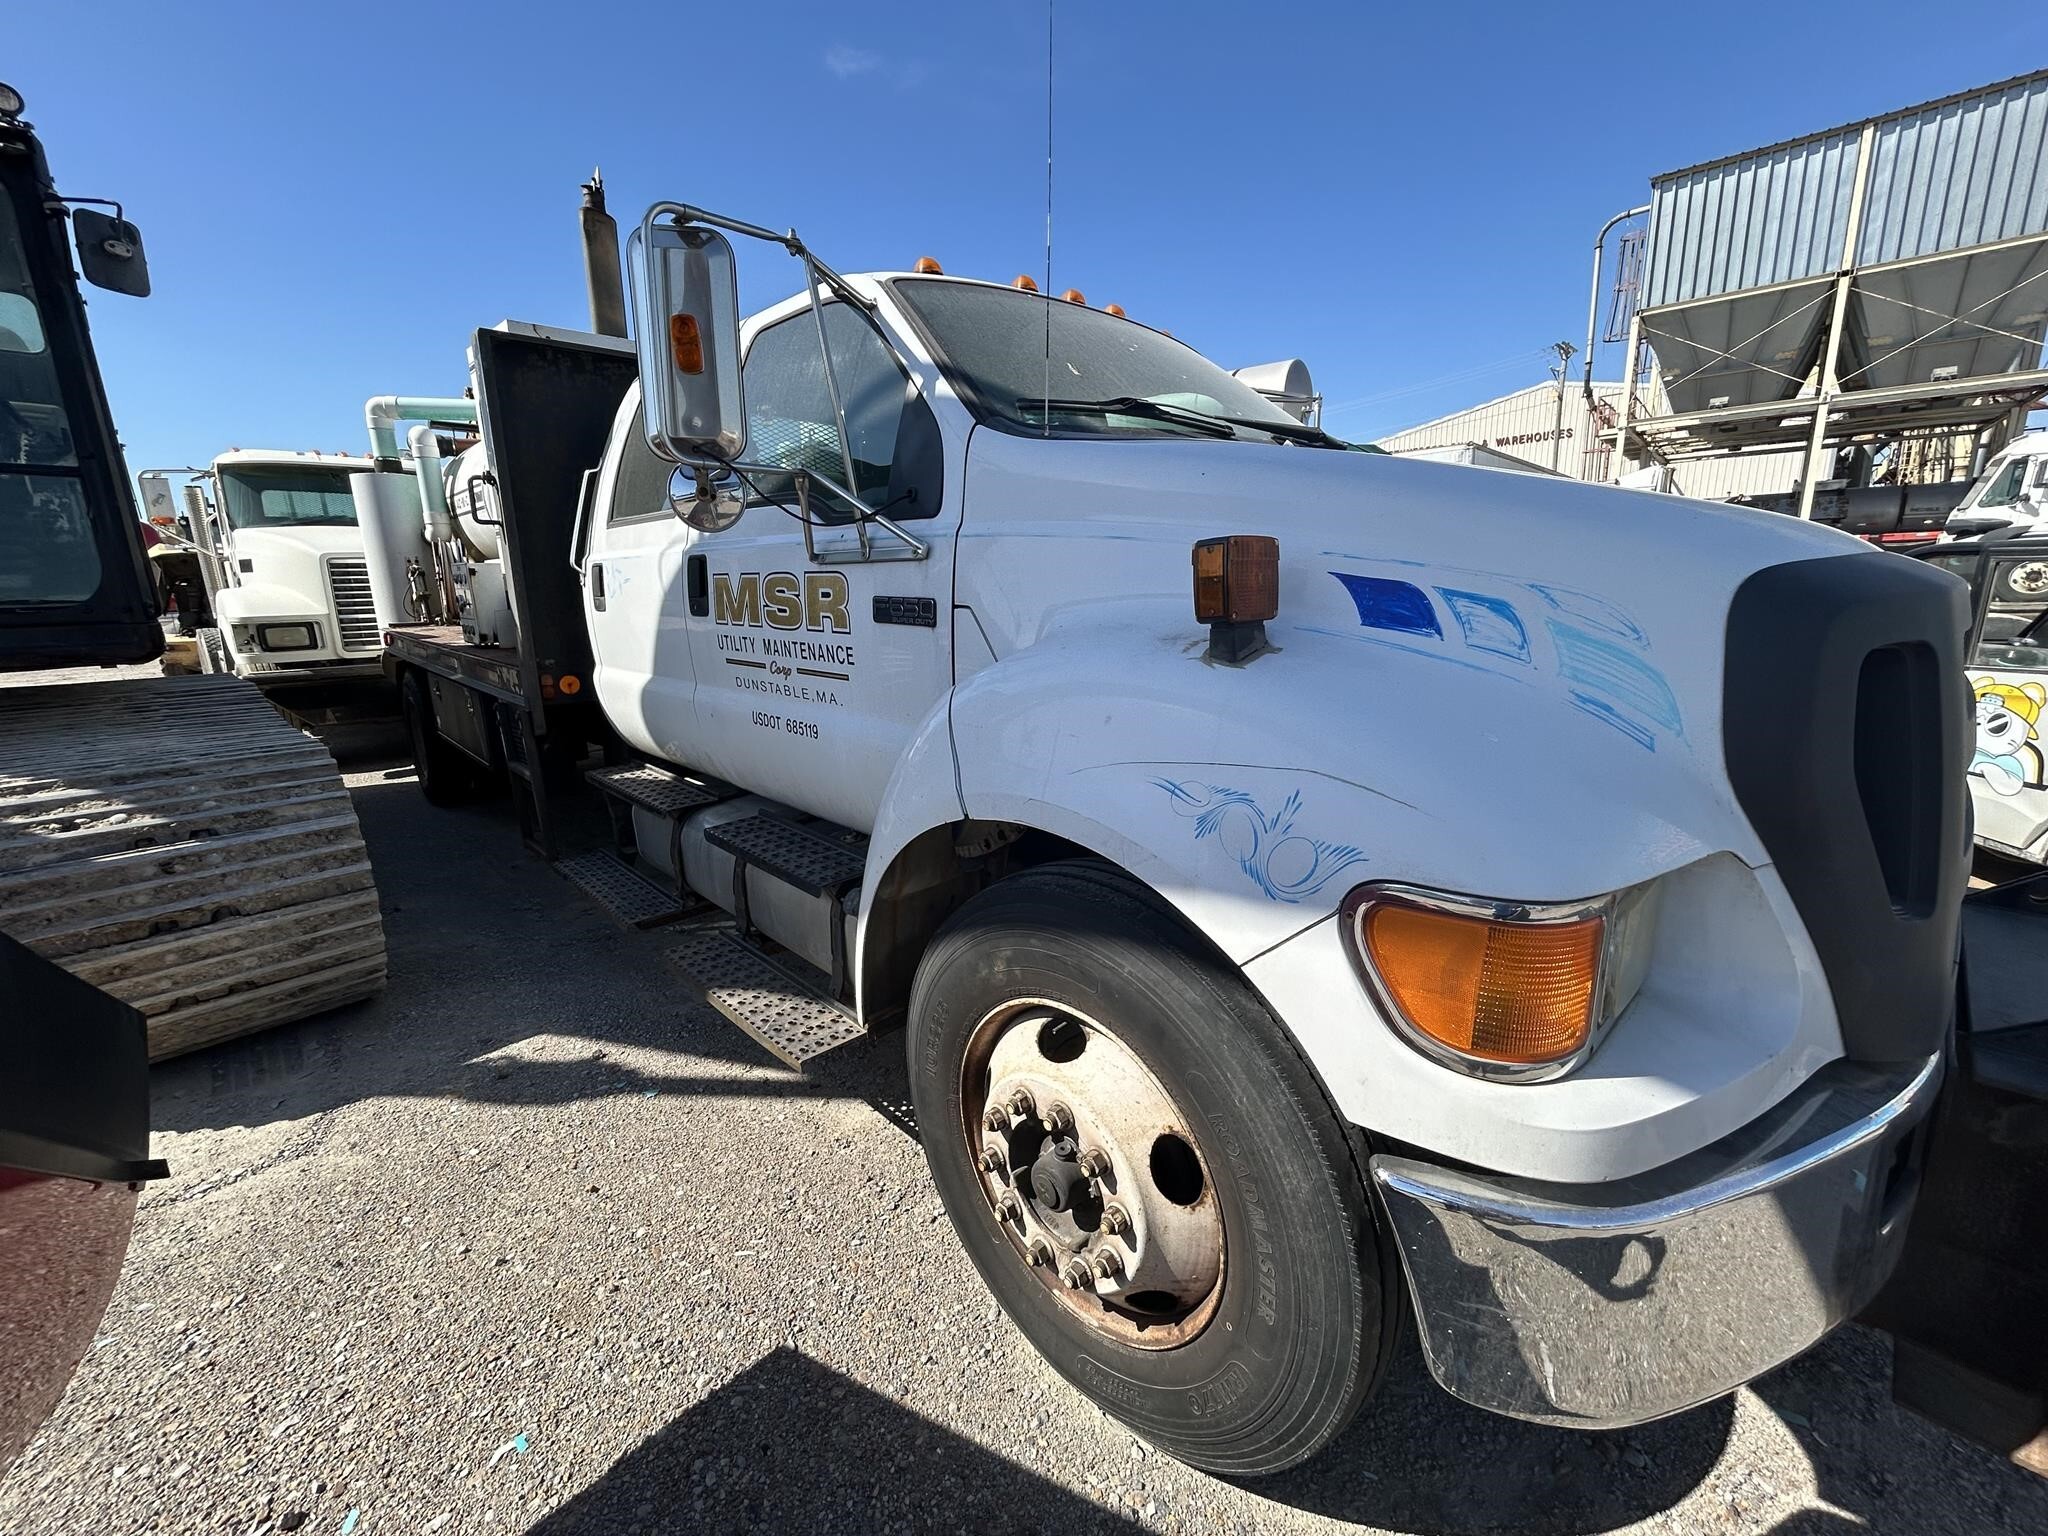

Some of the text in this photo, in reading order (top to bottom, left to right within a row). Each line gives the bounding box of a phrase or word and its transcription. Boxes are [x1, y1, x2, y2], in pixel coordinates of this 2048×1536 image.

[1496, 428, 1574, 447] WAREHOUSES
[713, 571, 851, 635] MSR
[915, 618, 935, 626] DUTY
[717, 633, 855, 666] UTILITY MAINTENANCE
[769, 660, 792, 681] Corp
[752, 710, 819, 740] USDOT 685119
[1208, 1112, 1278, 1327] ROADMASTER
